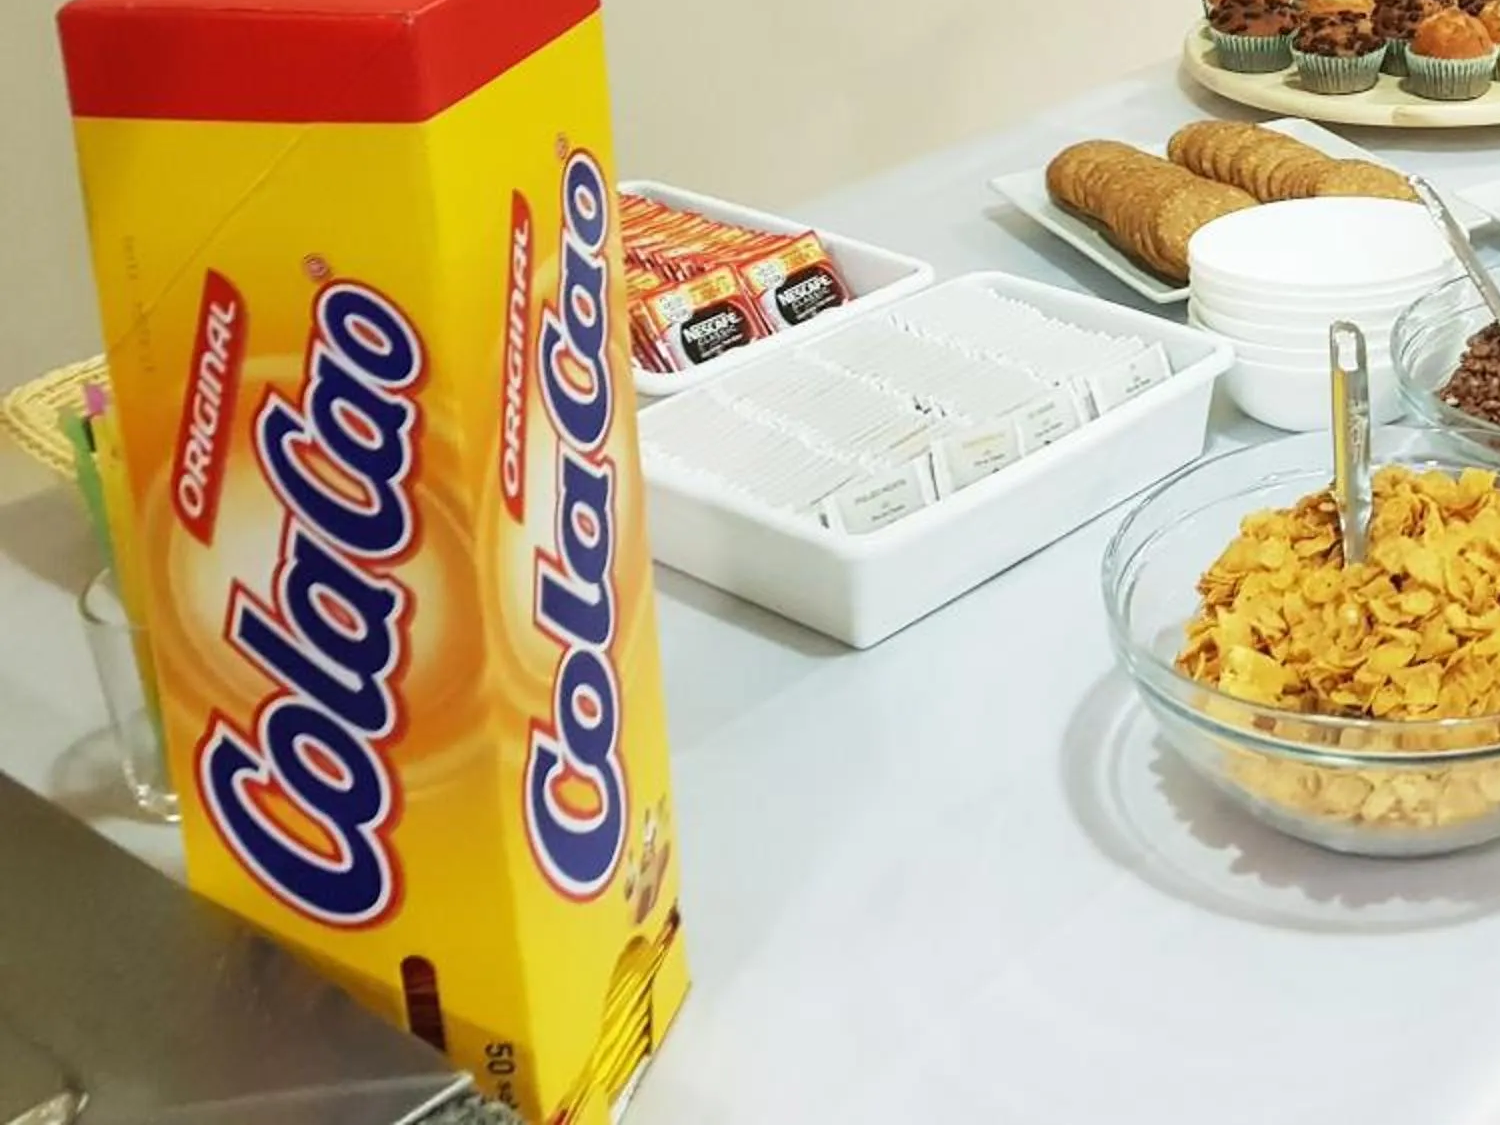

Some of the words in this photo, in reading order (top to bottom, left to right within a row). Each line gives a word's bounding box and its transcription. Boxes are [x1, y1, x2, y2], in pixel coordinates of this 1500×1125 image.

[178, 300, 236, 518] ORIGINAL
[502, 218, 529, 498] ORIGINAL
[199, 279, 423, 925] ColaCao
[523, 148, 629, 901] ColaCao
[485, 1042, 516, 1075] 50
